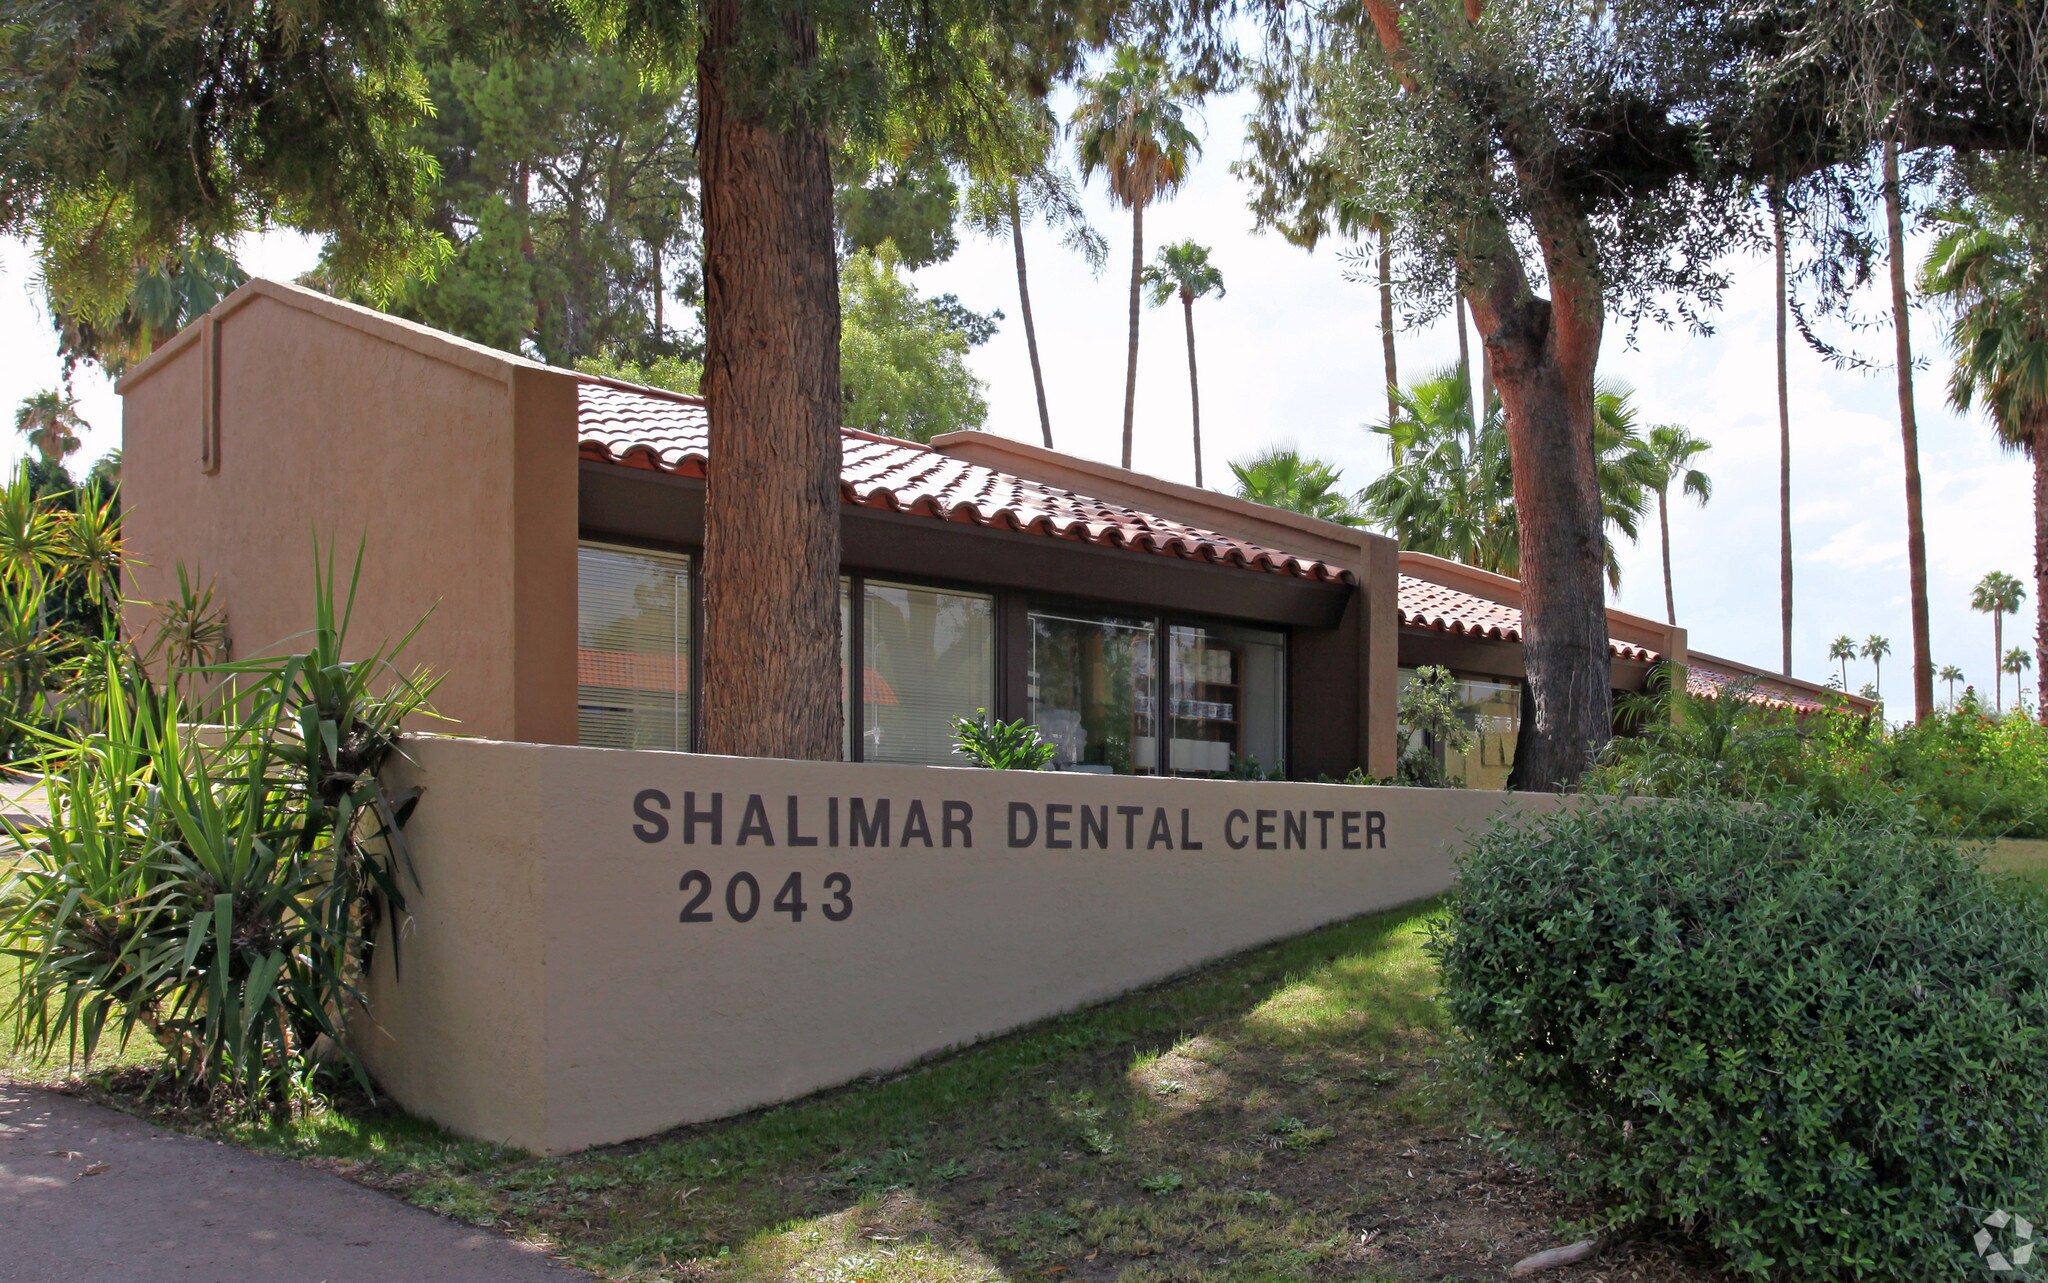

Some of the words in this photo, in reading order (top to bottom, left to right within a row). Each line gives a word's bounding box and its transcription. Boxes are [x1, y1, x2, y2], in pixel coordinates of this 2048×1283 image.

[633, 788, 974, 849] SHALIMAR
[1007, 802, 1203, 851] DENTAL
[1223, 808, 1388, 851] CENTER
[678, 869, 854, 924] 2043
